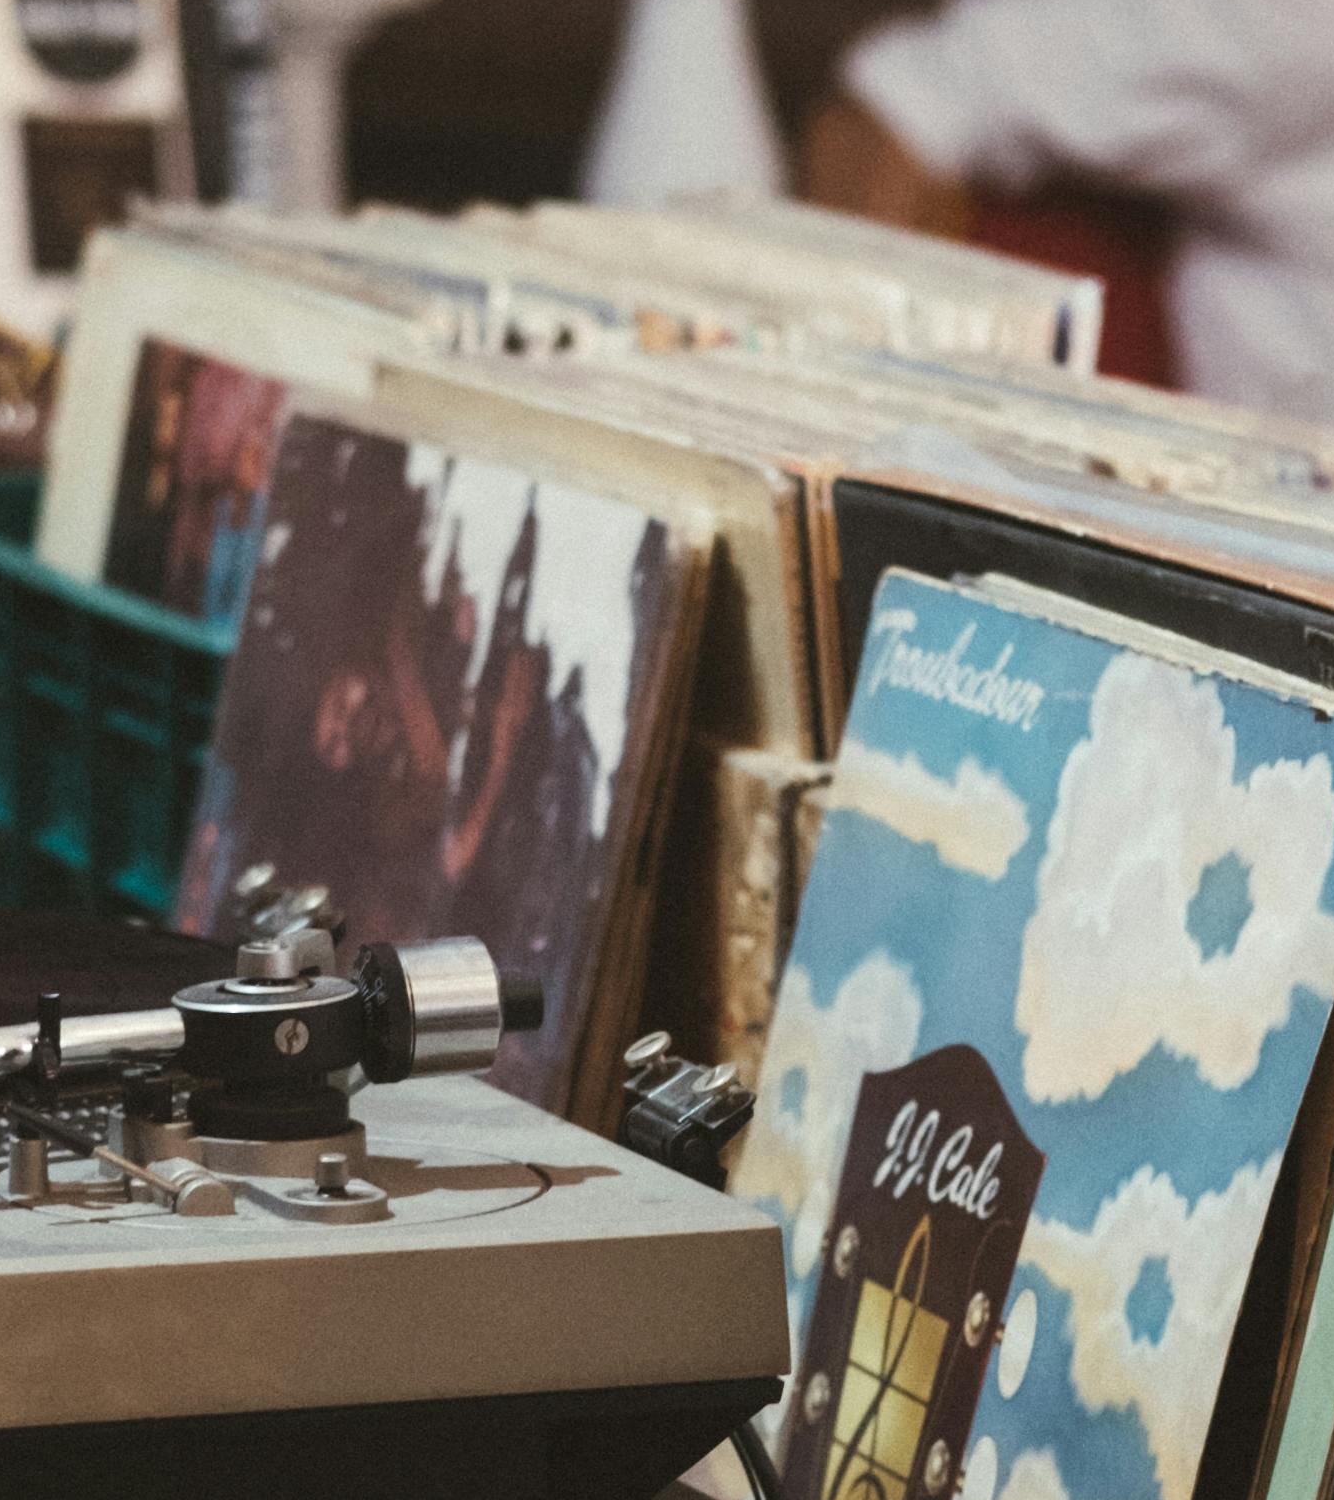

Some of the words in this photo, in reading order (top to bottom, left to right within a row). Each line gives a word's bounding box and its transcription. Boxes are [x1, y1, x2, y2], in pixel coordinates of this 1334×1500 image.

[869, 609, 1046, 732] Troubadour
[873, 1099, 941, 1199] J.J.
[928, 1124, 1004, 1219] Cale
